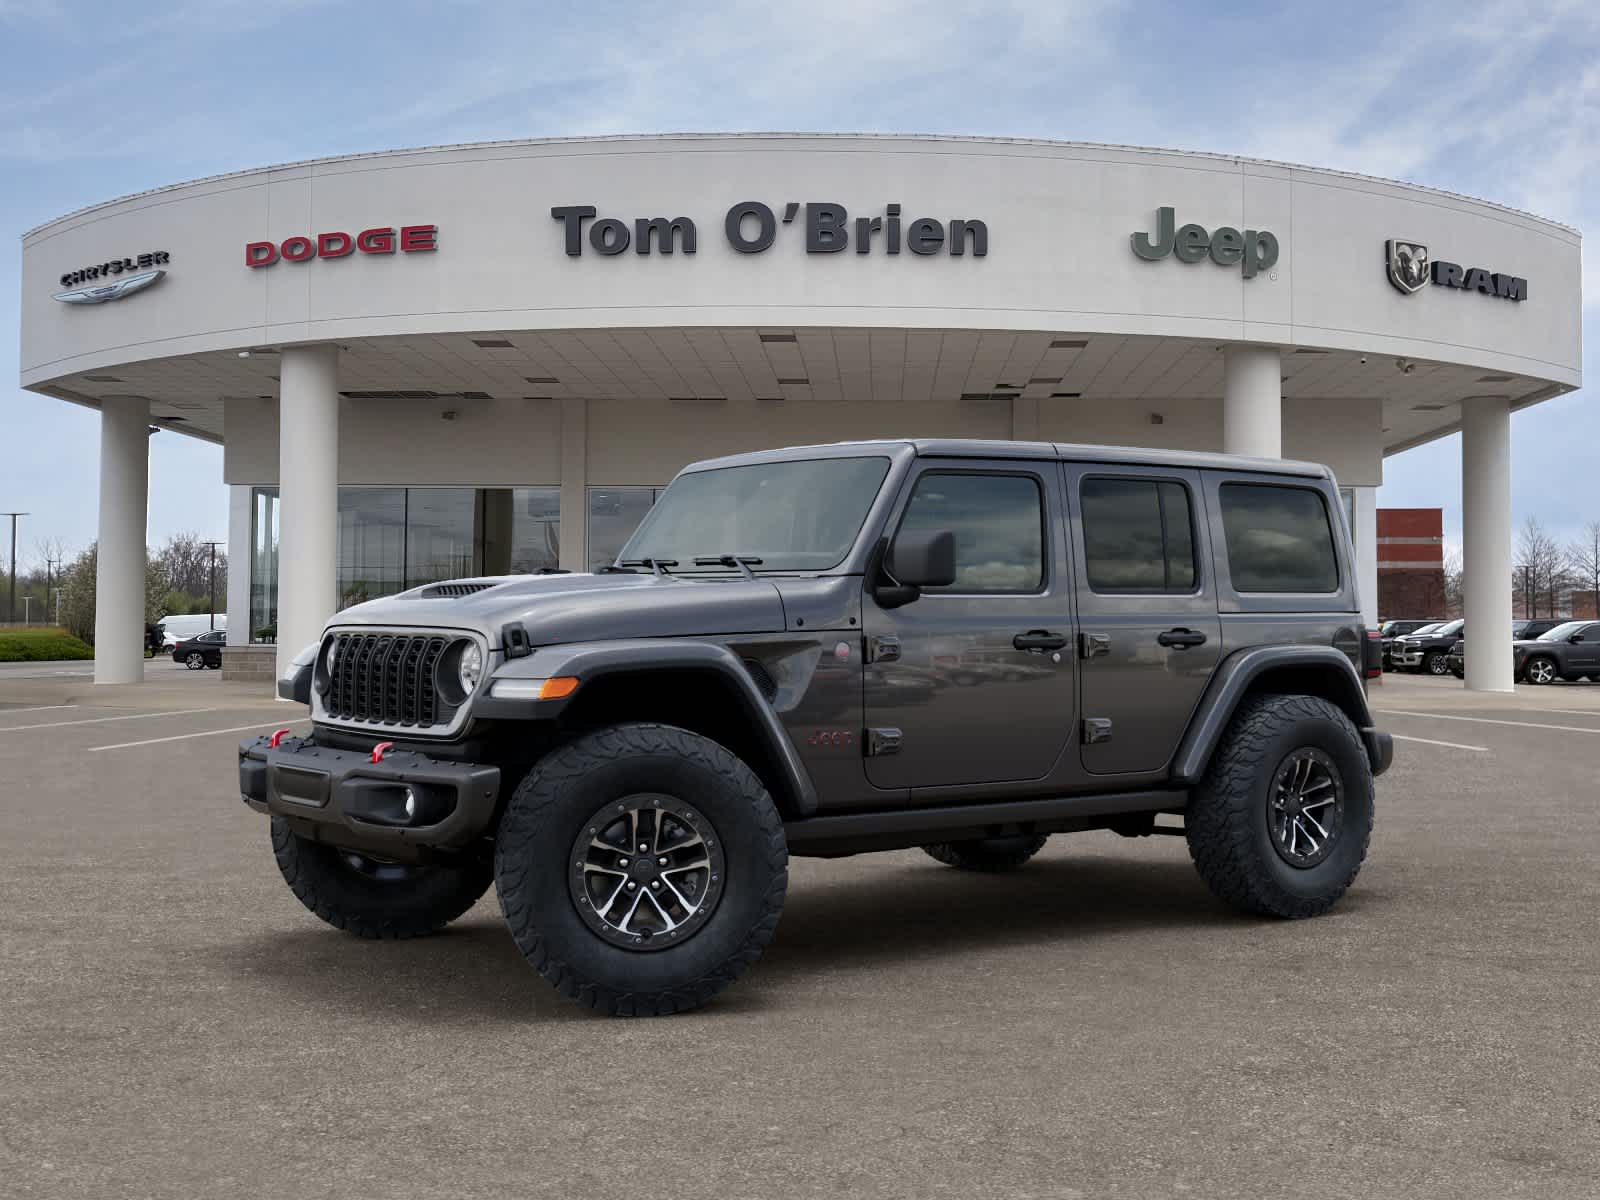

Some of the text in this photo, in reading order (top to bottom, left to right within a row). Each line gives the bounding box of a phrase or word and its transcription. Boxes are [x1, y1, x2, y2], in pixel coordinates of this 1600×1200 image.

[246, 225, 438, 268] DODGE
[551, 201, 988, 257] Tom O'Brien
[1130, 207, 1279, 278] Jeep
[60, 251, 169, 286] CHRYSLER
[1431, 261, 1527, 301] RAM
